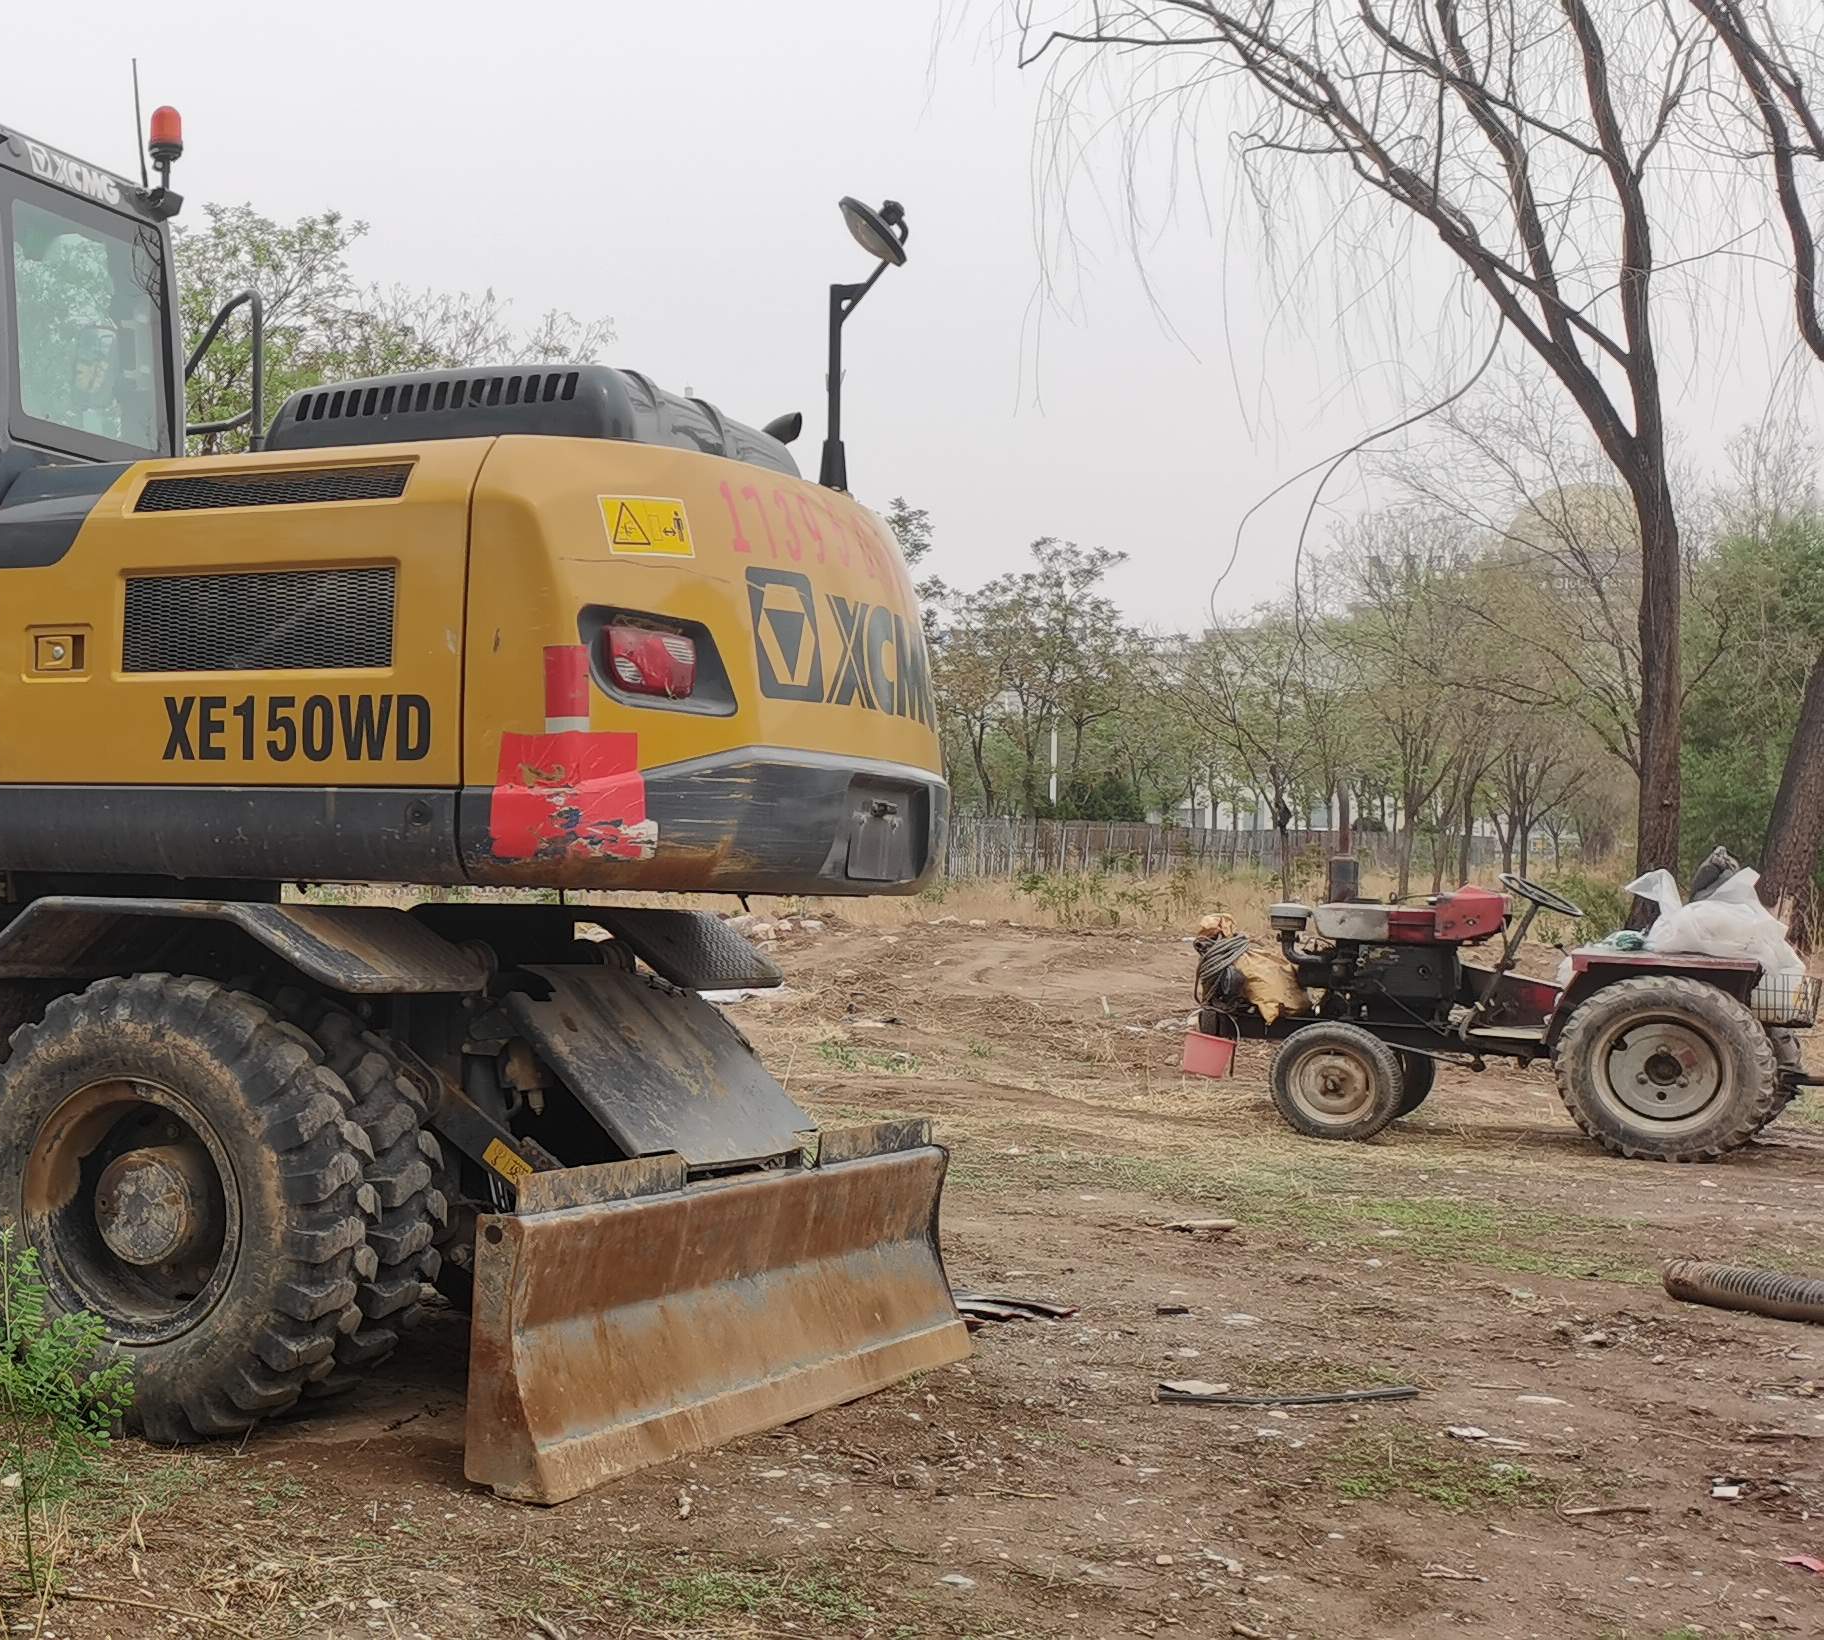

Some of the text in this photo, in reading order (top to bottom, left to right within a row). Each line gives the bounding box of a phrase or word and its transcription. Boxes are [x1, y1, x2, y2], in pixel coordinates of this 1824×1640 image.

[52, 155, 120, 205] XCMG
[825, 593, 936, 733] XCM
[162, 694, 432, 762] XE150WD
